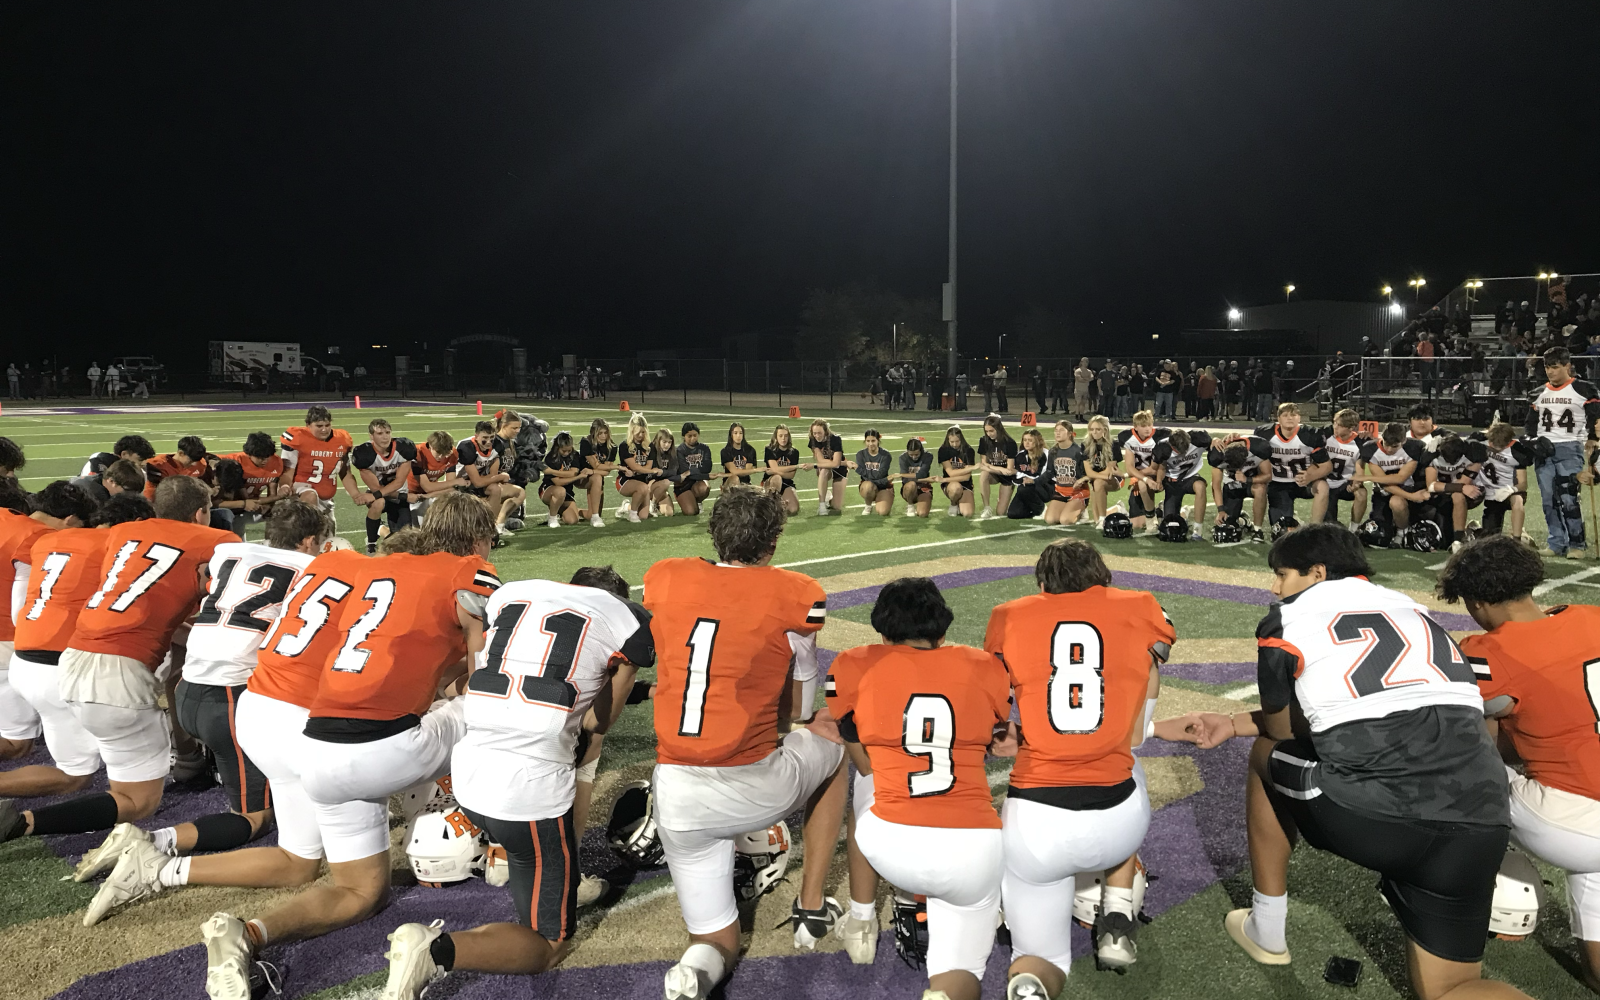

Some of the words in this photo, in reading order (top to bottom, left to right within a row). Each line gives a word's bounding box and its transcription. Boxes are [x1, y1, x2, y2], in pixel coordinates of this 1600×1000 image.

[1022, 414, 1033, 425] 20
[1326, 446, 1355, 457] BULLDOGS
[1362, 422, 1375, 434] 30
[1541, 408, 1576, 434] 44
[86, 540, 185, 614] 17
[190, 557, 299, 636] 12
[258, 574, 354, 658] 15
[331, 577, 397, 674] 2
[467, 600, 580, 712] 11
[677, 616, 720, 737] 1
[1047, 620, 1105, 735] 8
[901, 693, 957, 798] 9
[1523, 914, 1531, 923] 6
